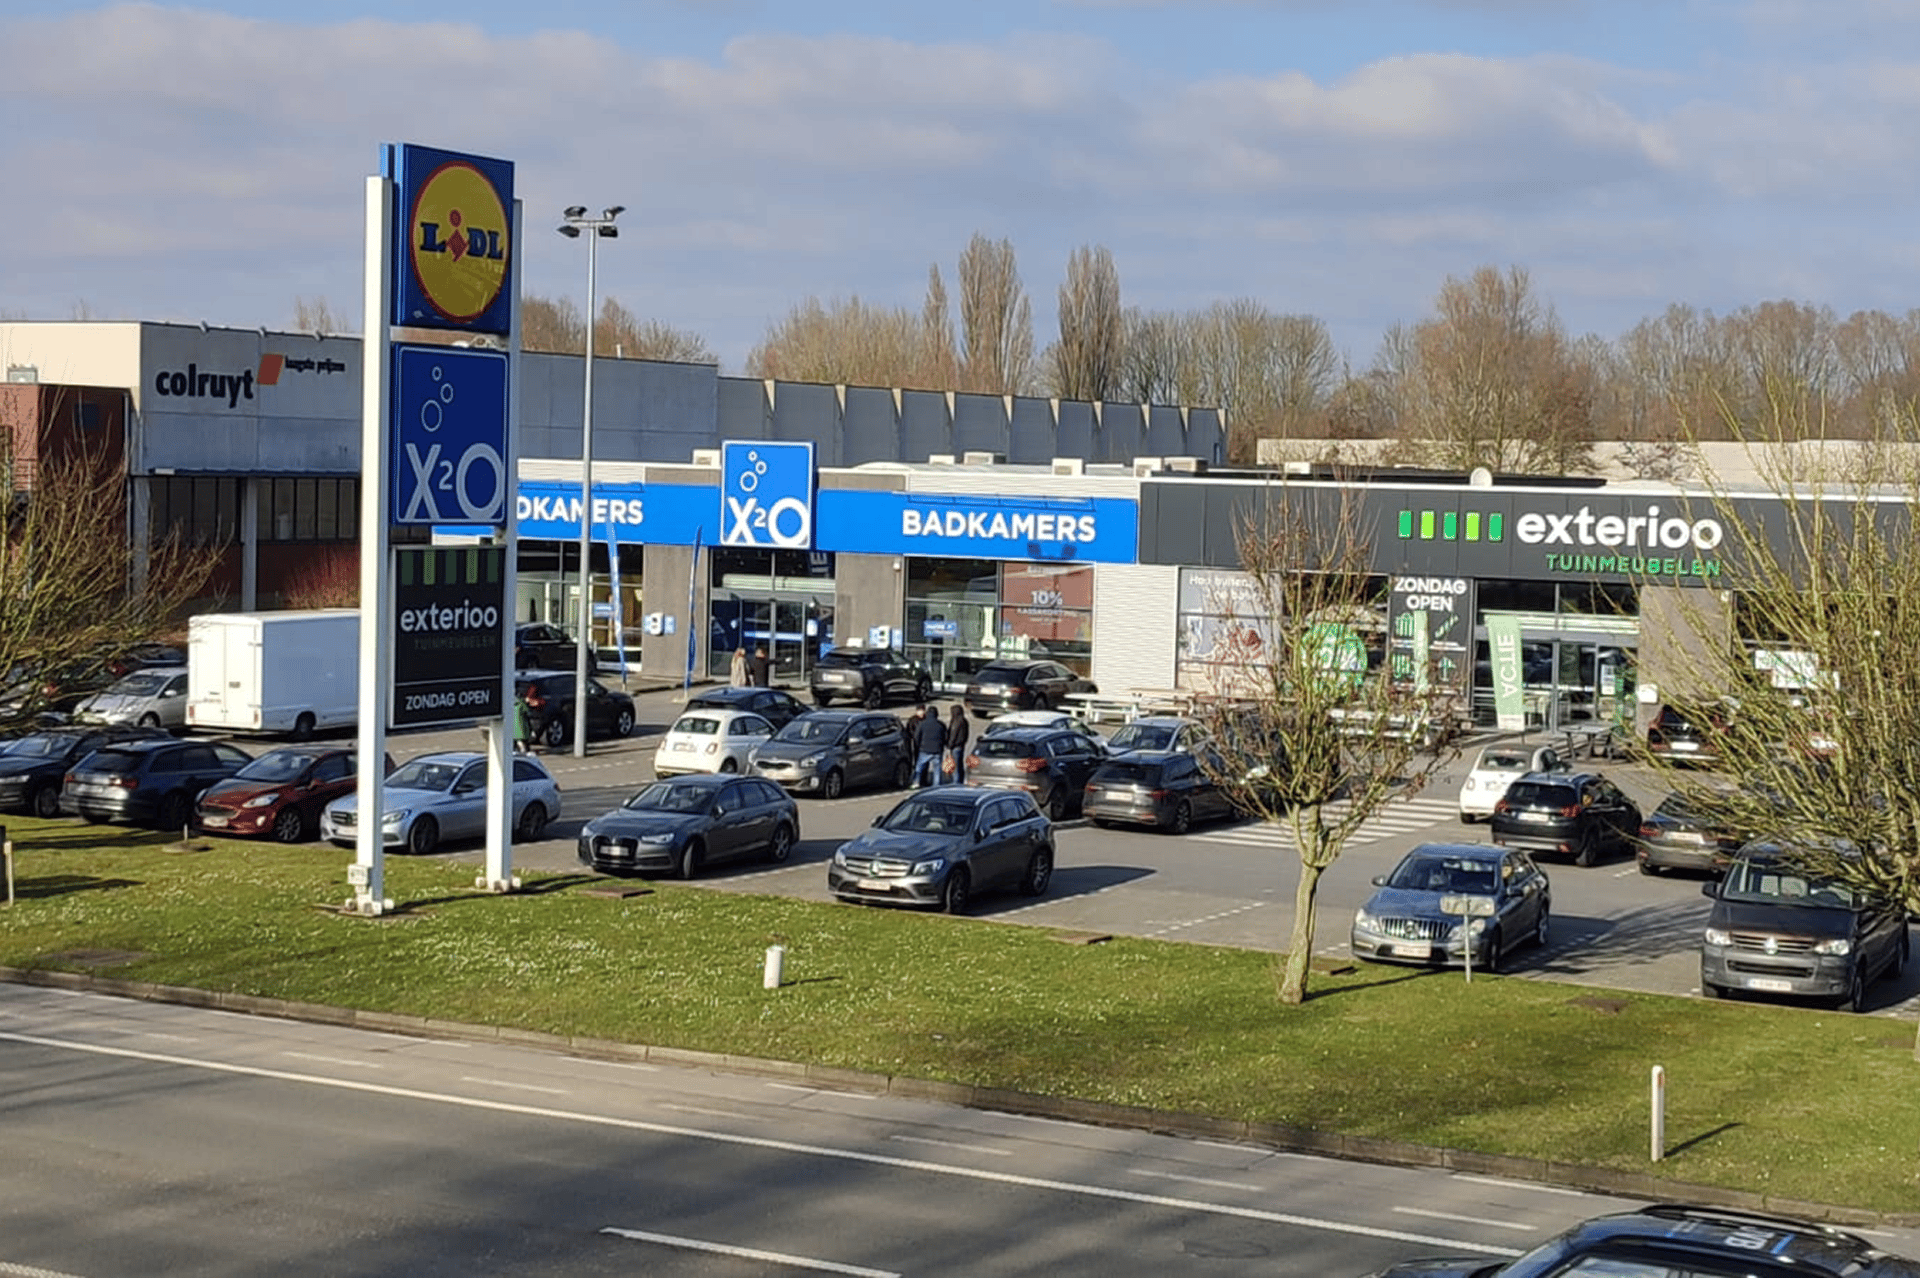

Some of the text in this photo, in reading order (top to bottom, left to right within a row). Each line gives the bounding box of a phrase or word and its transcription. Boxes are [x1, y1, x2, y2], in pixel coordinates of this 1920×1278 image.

[155, 363, 254, 409] colruyt
[517, 496, 644, 524] DKAMERS
[902, 510, 1096, 542] BADKAMERS
[1516, 506, 1723, 550] exterioo
[1545, 553, 1721, 576] TUINMEUBELEN
[1031, 590, 1063, 606] 10%
[1394, 577, 1467, 595] ZONDAG
[400, 598, 498, 631] exterioo
[1406, 594, 1453, 612] OPEN
[405, 689, 491, 711] ZONDAG OPEN
